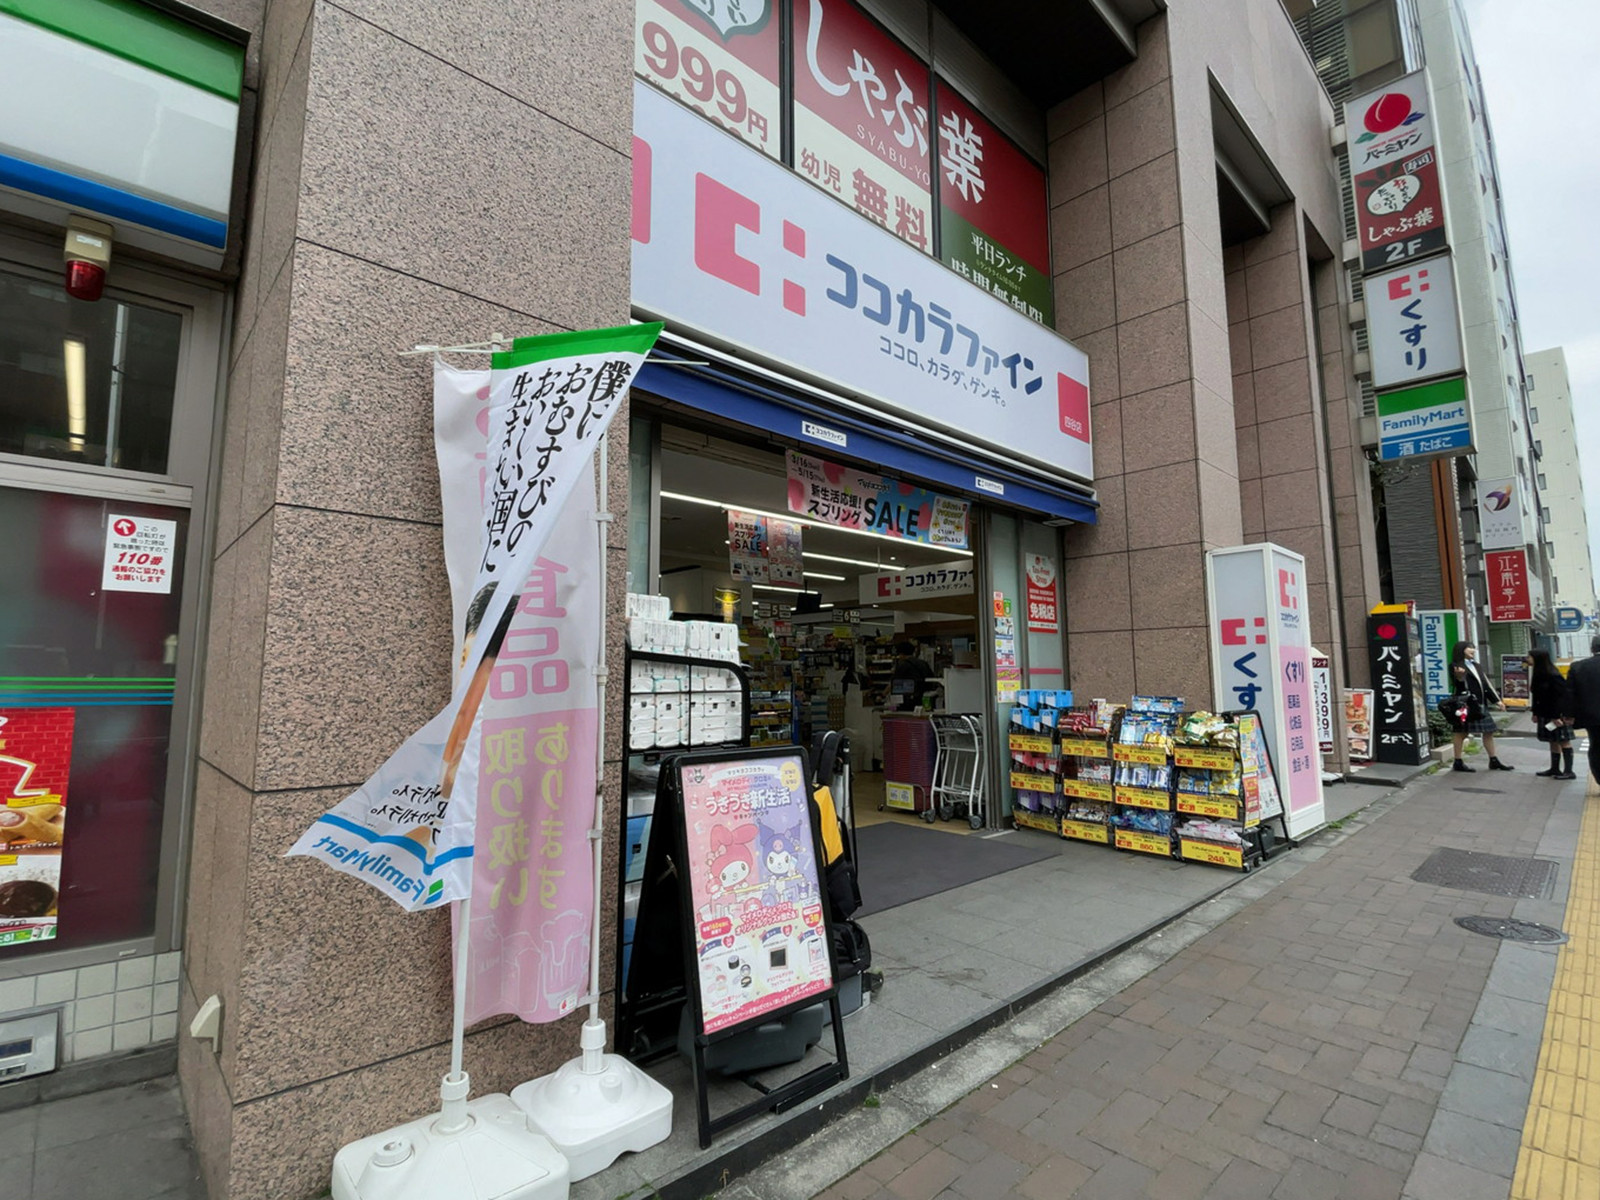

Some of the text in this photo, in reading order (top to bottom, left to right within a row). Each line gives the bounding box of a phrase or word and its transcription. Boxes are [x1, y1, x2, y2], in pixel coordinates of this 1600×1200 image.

[642, 20, 768, 143] 999円
[856, 123, 931, 187] SYABU-YO
[1363, 132, 1422, 165] バーミヤン
[800, 146, 842, 193] 幼児
[1368, 206, 1434, 242] しゃぶ葉
[971, 232, 1027, 282] 平日ランチ
[1386, 238, 1422, 263] 2F
[826, 252, 1043, 396] ココカラファイン
[1400, 298, 1427, 371] くすり
[879, 335, 1007, 408] ココロ、カラダ、ゲンキ。
[1382, 407, 1465, 431] FamilyMart
[1398, 436, 1453, 456] 酒 たばこ
[811, 483, 862, 509] 新生活応援!
[807, 499, 862, 525] スプリング
[863, 497, 921, 538] SALE
[117, 551, 163, 566] 110番
[734, 538, 762, 552] SALE
[115, 573, 162, 583] お願いします
[771, 604, 778, 615] 5
[1030, 602, 1055, 620] 免税店
[1424, 615, 1444, 690] FamilyMart
[1377, 646, 1403, 724] バーミヤン
[1381, 734, 1399, 744] 2F
[706, 786, 791, 816] うきうき新生活
